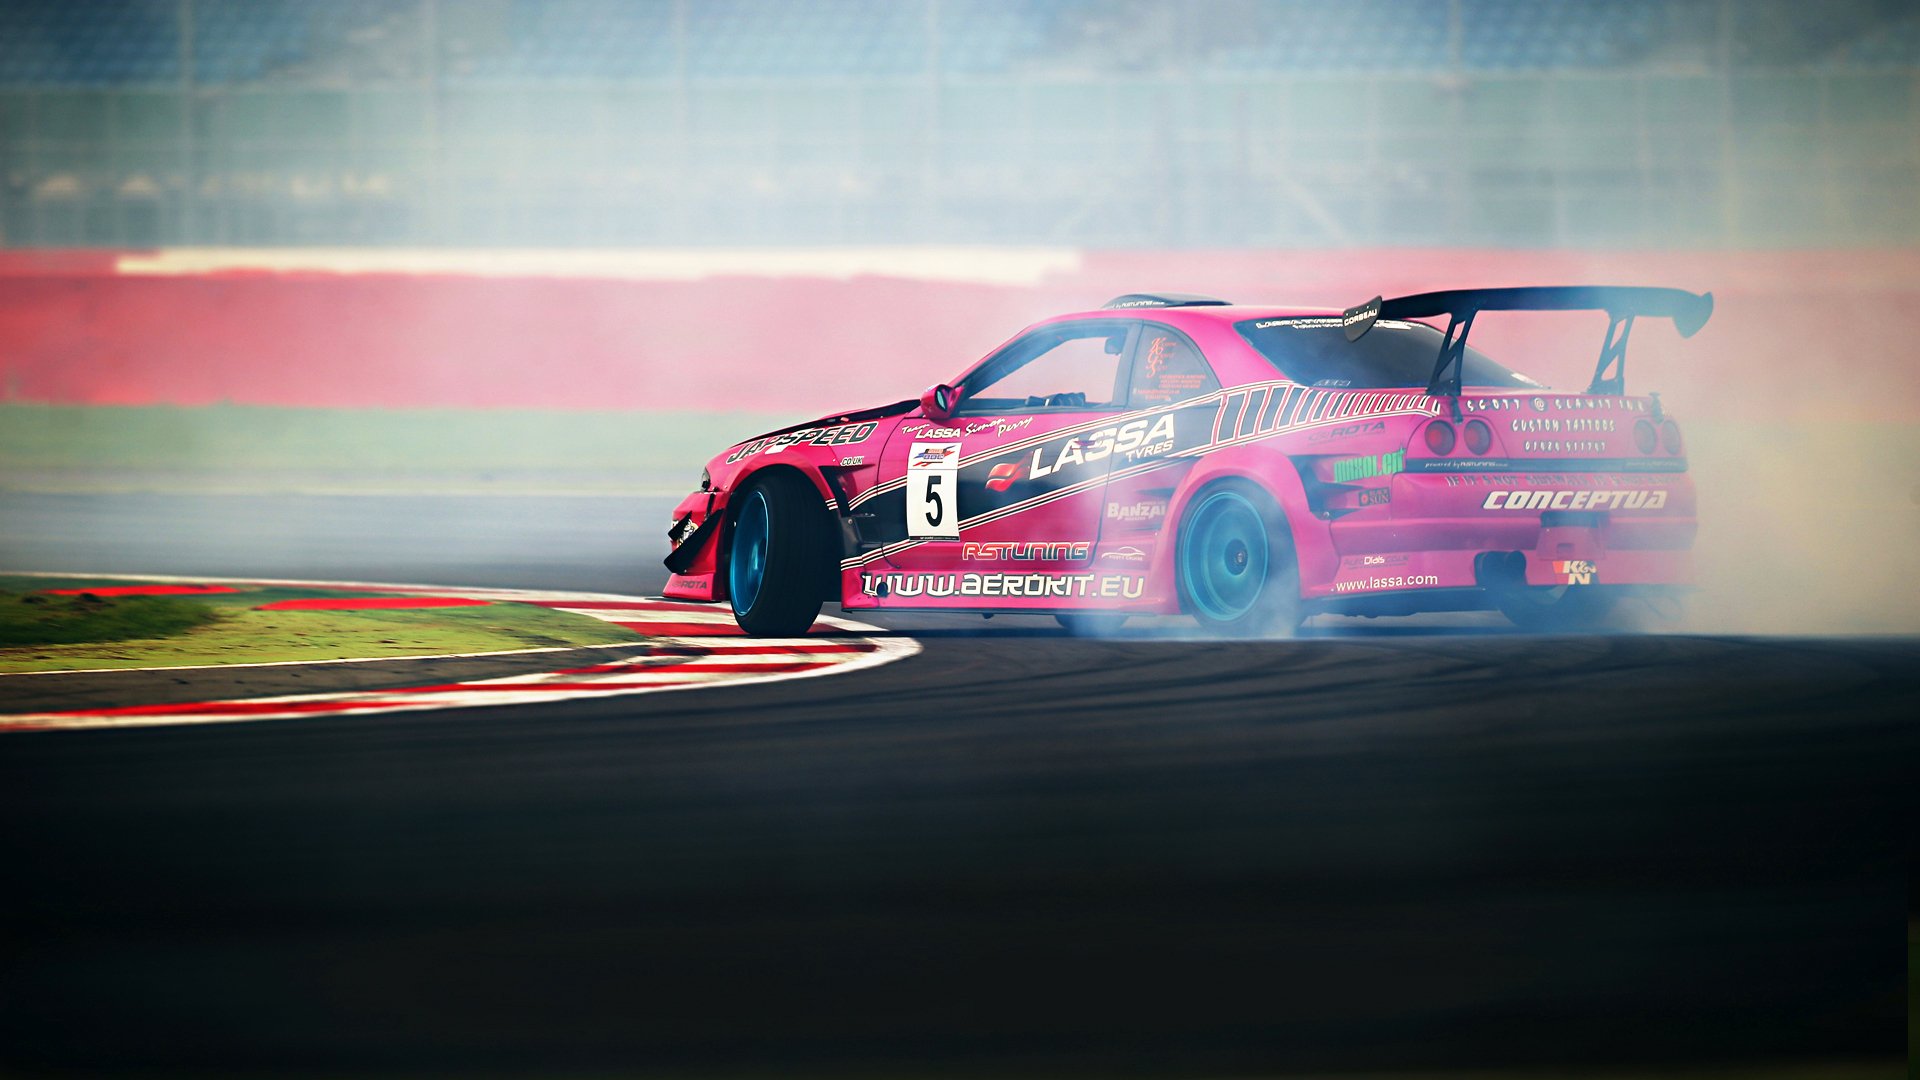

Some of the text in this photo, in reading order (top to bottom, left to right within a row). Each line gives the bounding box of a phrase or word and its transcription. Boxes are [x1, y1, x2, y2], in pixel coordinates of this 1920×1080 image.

[1343, 308, 1378, 327] CORBEAU
[1533, 397, 1545, 412] @
[901, 416, 1033, 439] Team LASSA Simon Perry
[1331, 421, 1385, 438] ROTA
[1512, 419, 1615, 433] CUSTOM TATTOOS
[1028, 413, 1175, 481] LASSA
[1125, 440, 1174, 462] TYRES
[925, 475, 943, 527] 5
[1482, 490, 1669, 510] CONCEPTUA
[1107, 502, 1166, 520] BANZAI
[962, 541, 1090, 561] RSTUNING
[681, 580, 708, 589] ROTA
[1336, 575, 1439, 592] www.lassa.com
